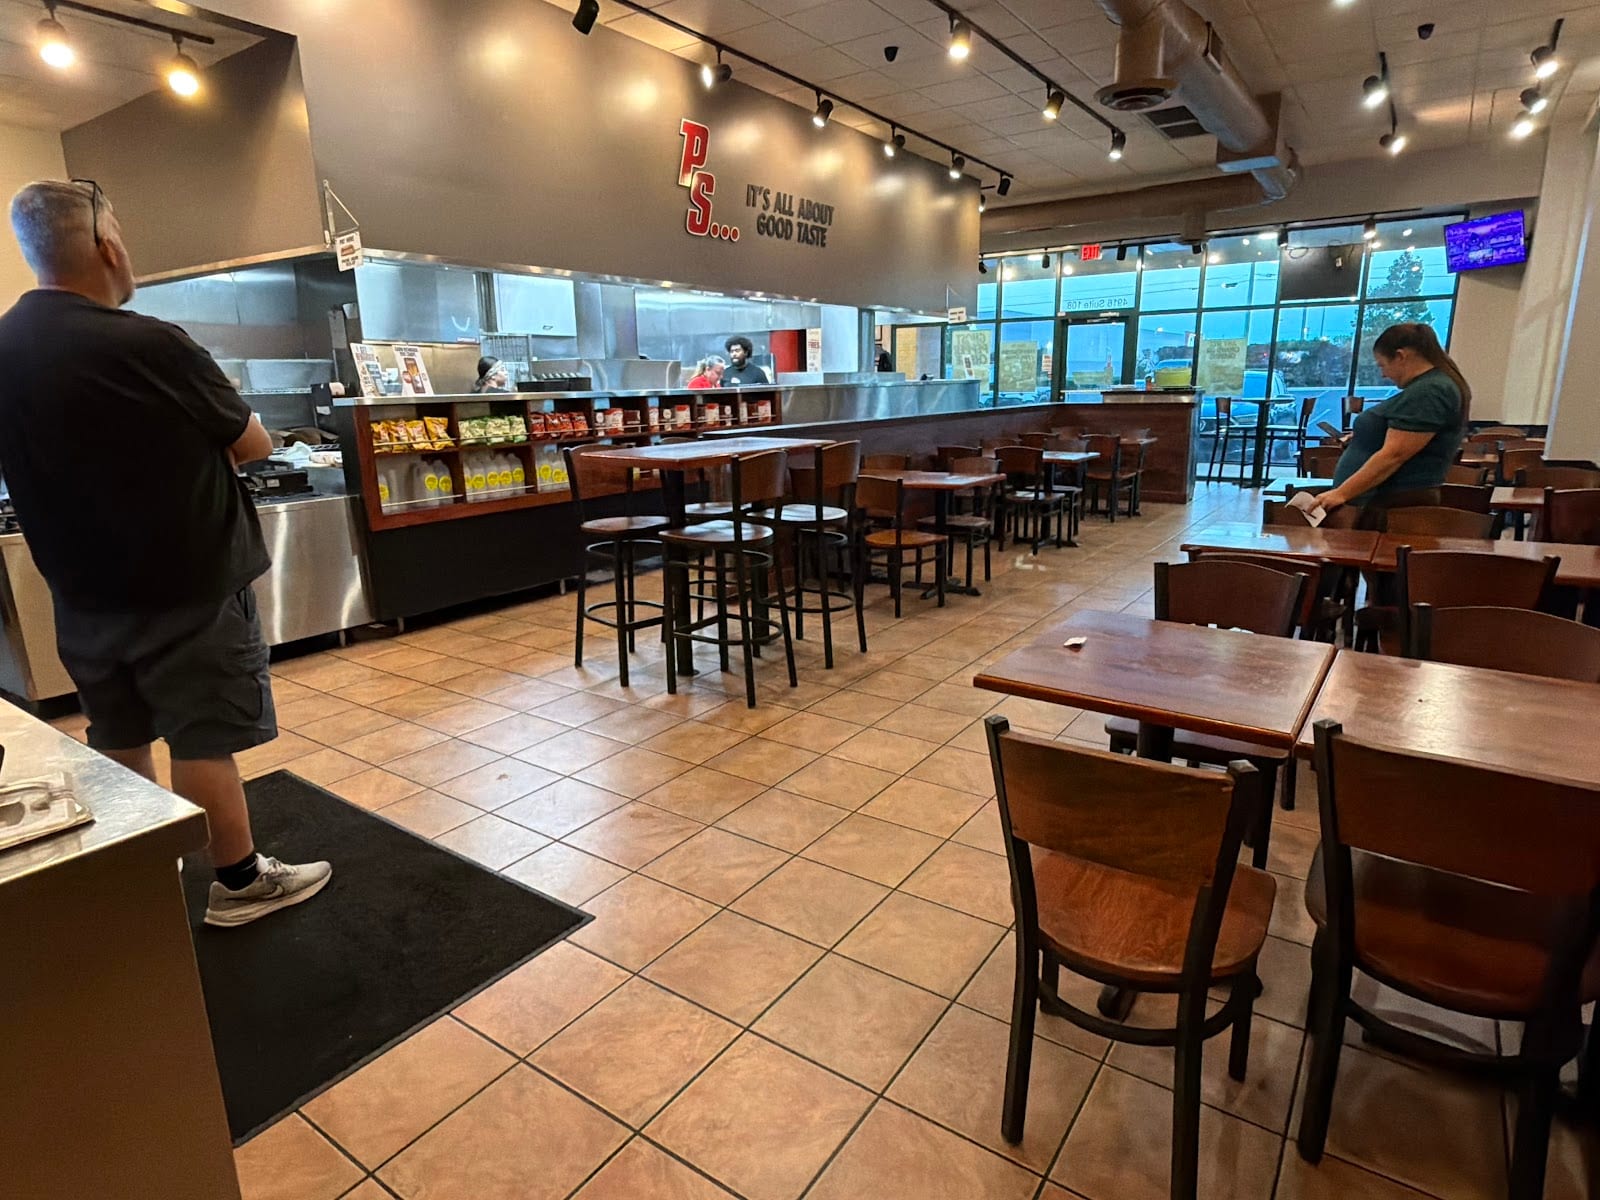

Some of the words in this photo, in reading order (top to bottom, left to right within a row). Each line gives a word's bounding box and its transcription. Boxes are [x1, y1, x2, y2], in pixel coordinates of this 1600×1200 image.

[746, 183, 771, 211] IT'S
[773, 191, 794, 217] ALL
[797, 198, 834, 226] ABOUT
[756, 212, 793, 241] GOOD
[797, 221, 828, 248] TASTE
[1083, 245, 1100, 261] EXIT
